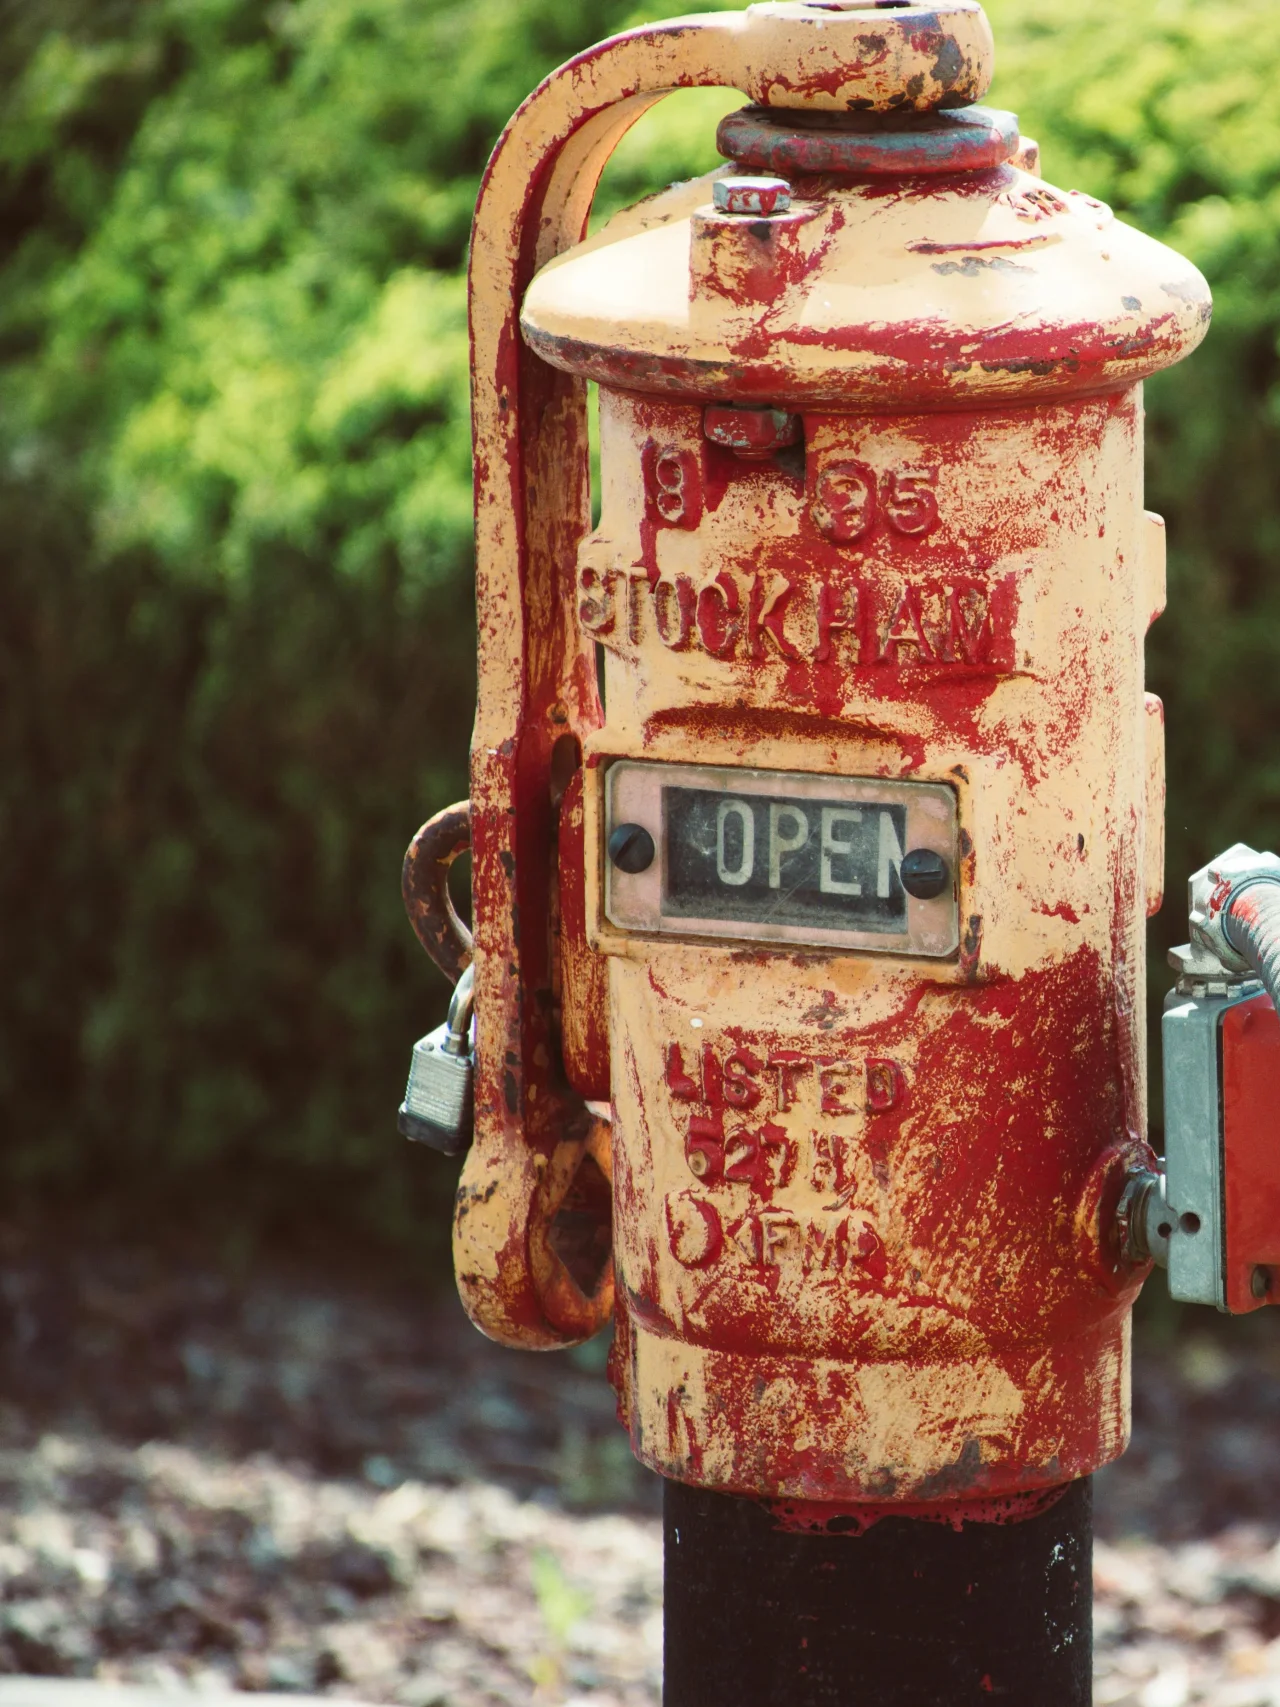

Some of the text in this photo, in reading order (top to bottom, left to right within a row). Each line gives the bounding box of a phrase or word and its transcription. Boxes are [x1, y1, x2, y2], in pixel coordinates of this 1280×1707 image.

[579, 566, 1016, 666] STOCKHAM
[716, 800, 906, 899] OPEN
[665, 1042, 906, 1114] LISTED
